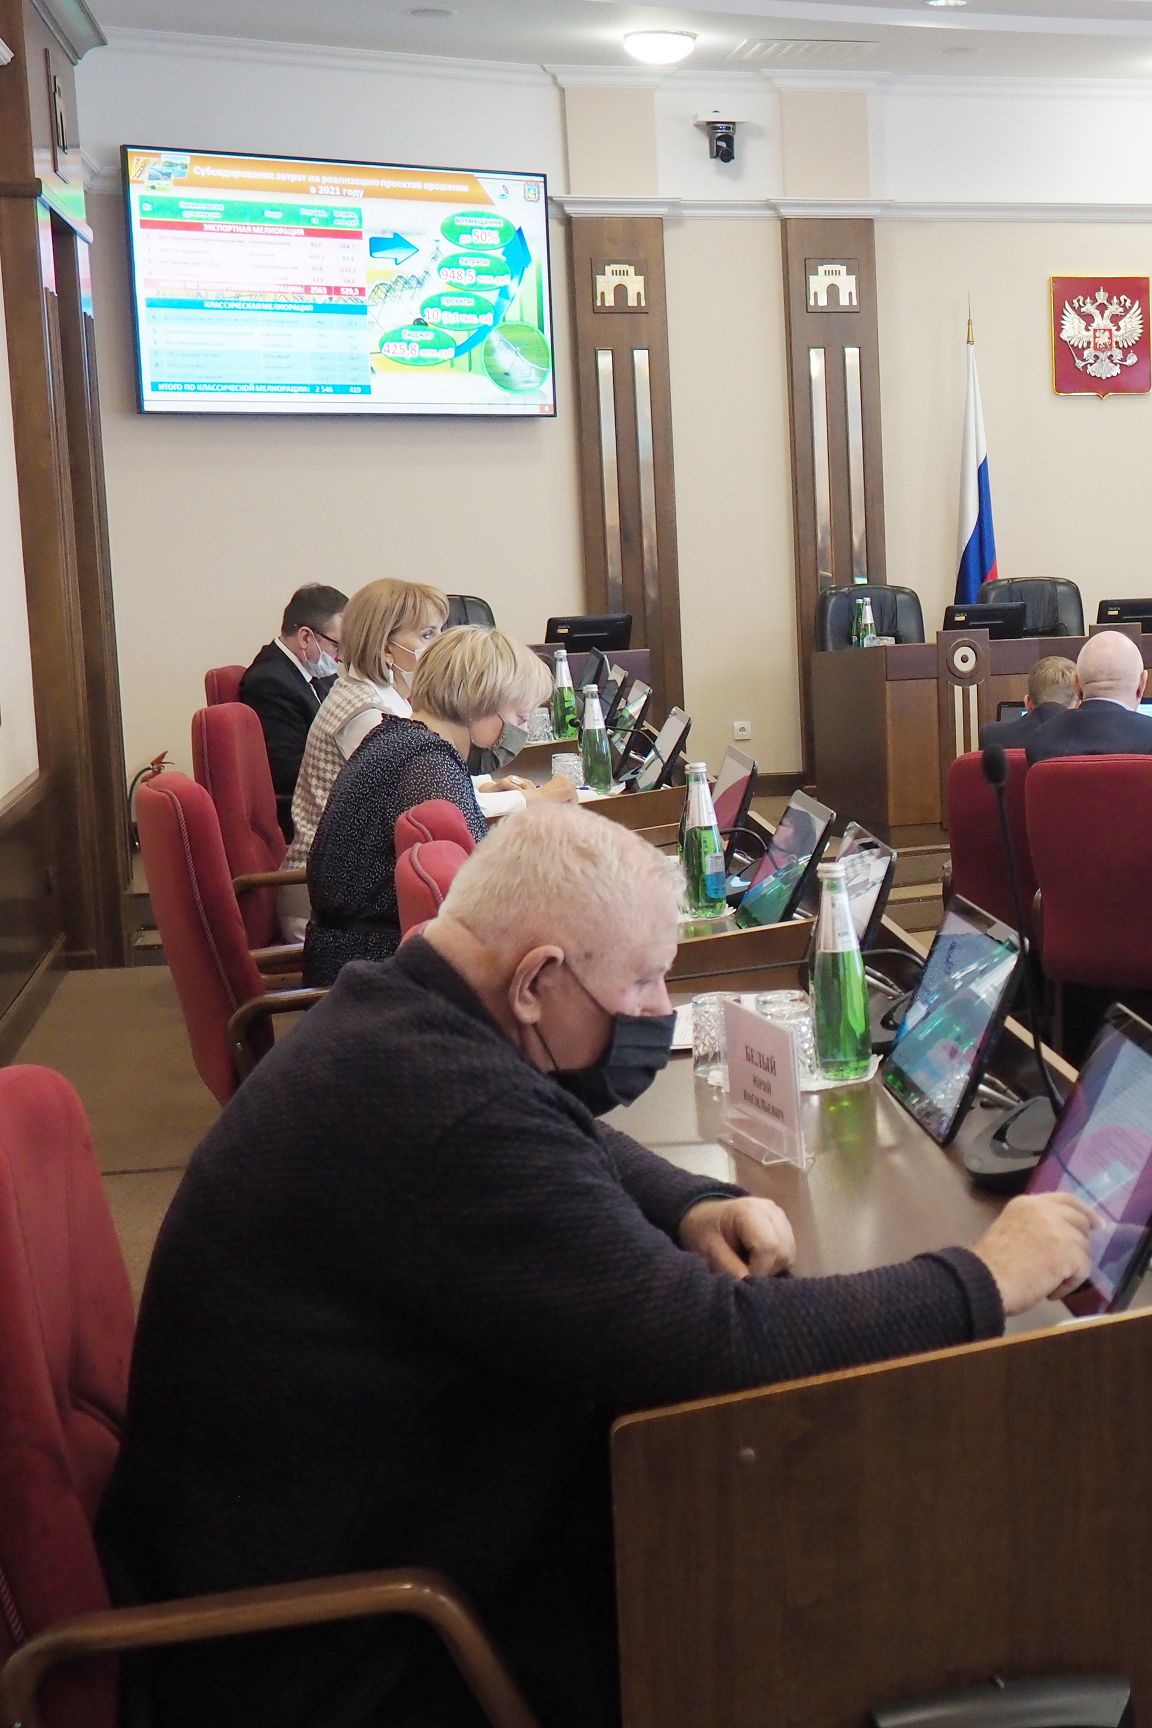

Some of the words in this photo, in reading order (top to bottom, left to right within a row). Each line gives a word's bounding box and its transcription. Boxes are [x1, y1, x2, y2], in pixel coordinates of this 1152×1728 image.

[319, 186, 341, 195] 2021
[473, 230, 499, 242] 50%
[383, 344, 418, 357] 425,8
[745, 1045, 776, 1076] БЕЛЫЙ
